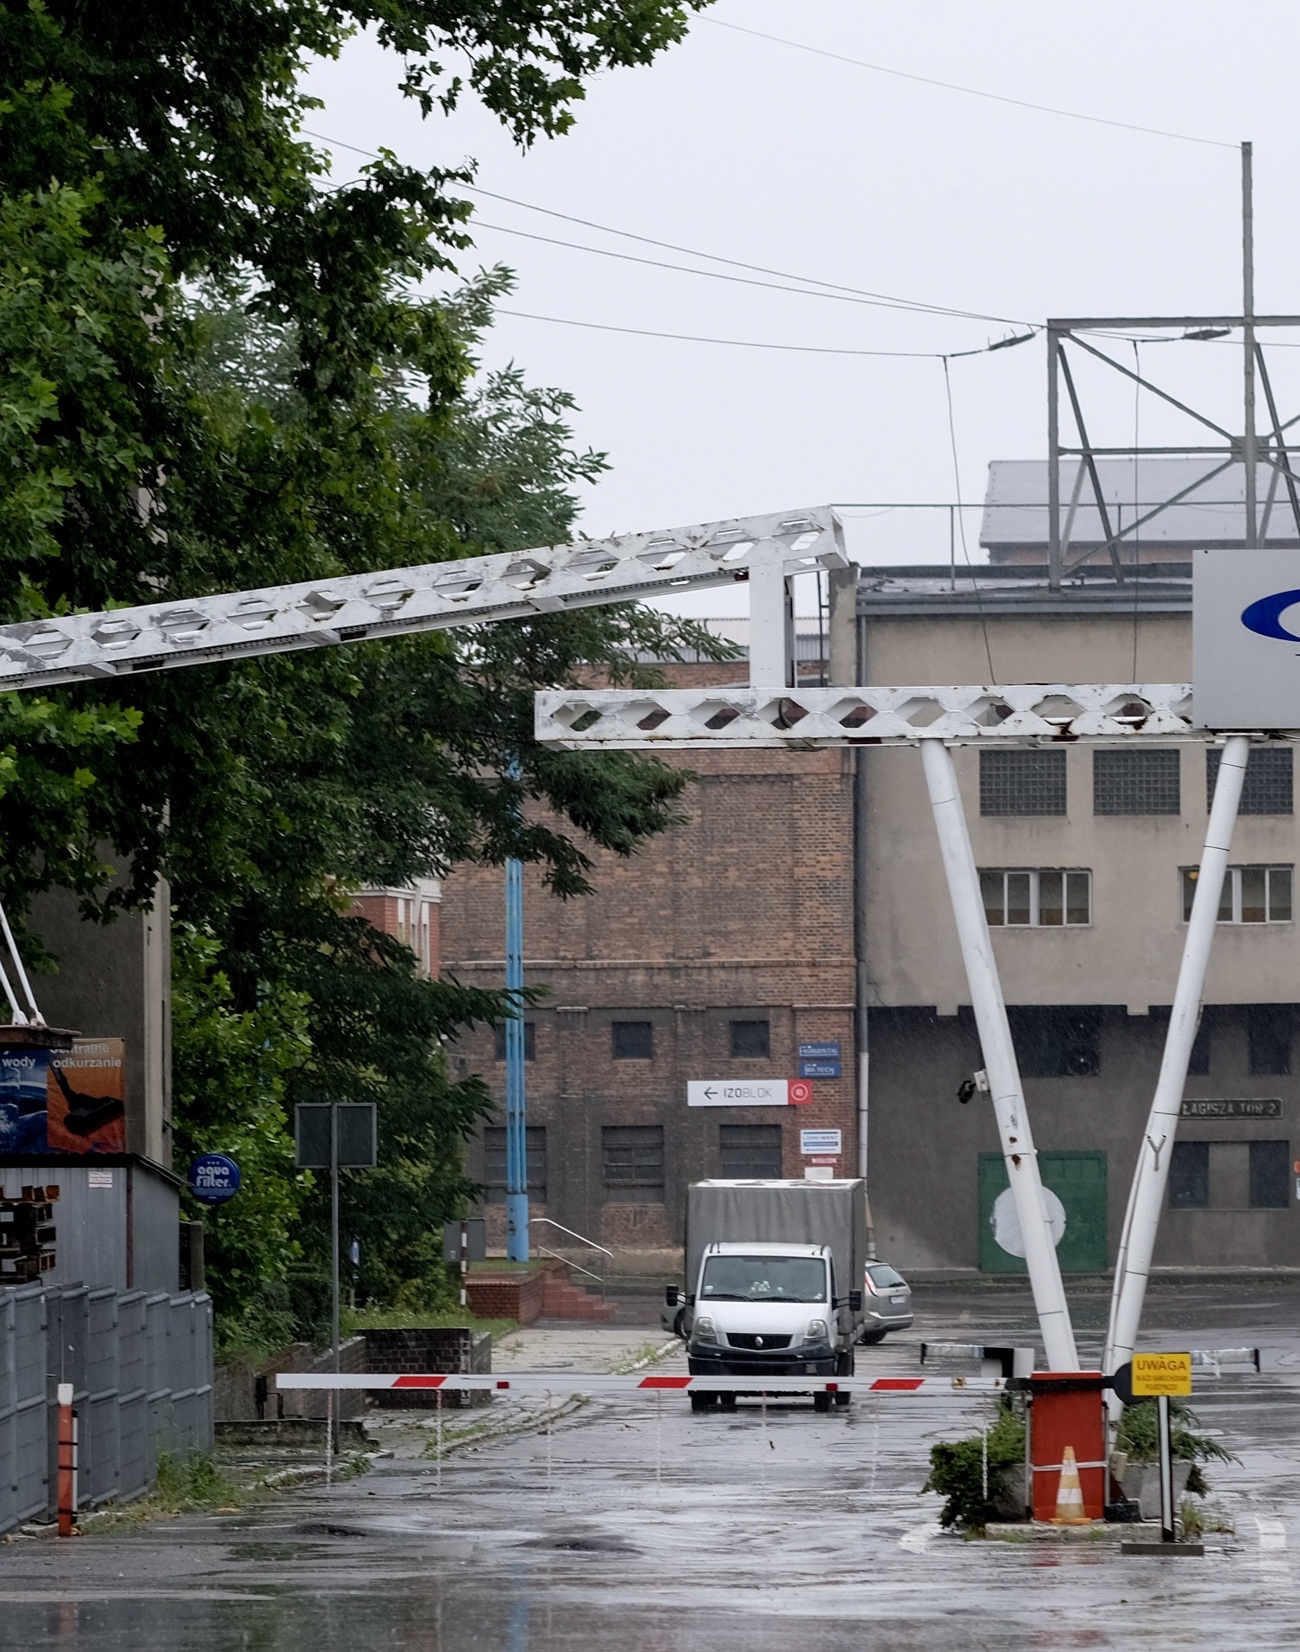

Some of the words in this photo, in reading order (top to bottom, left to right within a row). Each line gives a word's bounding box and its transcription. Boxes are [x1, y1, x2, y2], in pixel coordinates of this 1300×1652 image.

[2, 1056, 37, 1069] wody
[52, 1056, 123, 1069] odkurzanie
[723, 1087, 773, 1099] IZOBLOK
[197, 1166, 230, 1177] aqua
[1136, 1360, 1187, 1371] UWAGA
